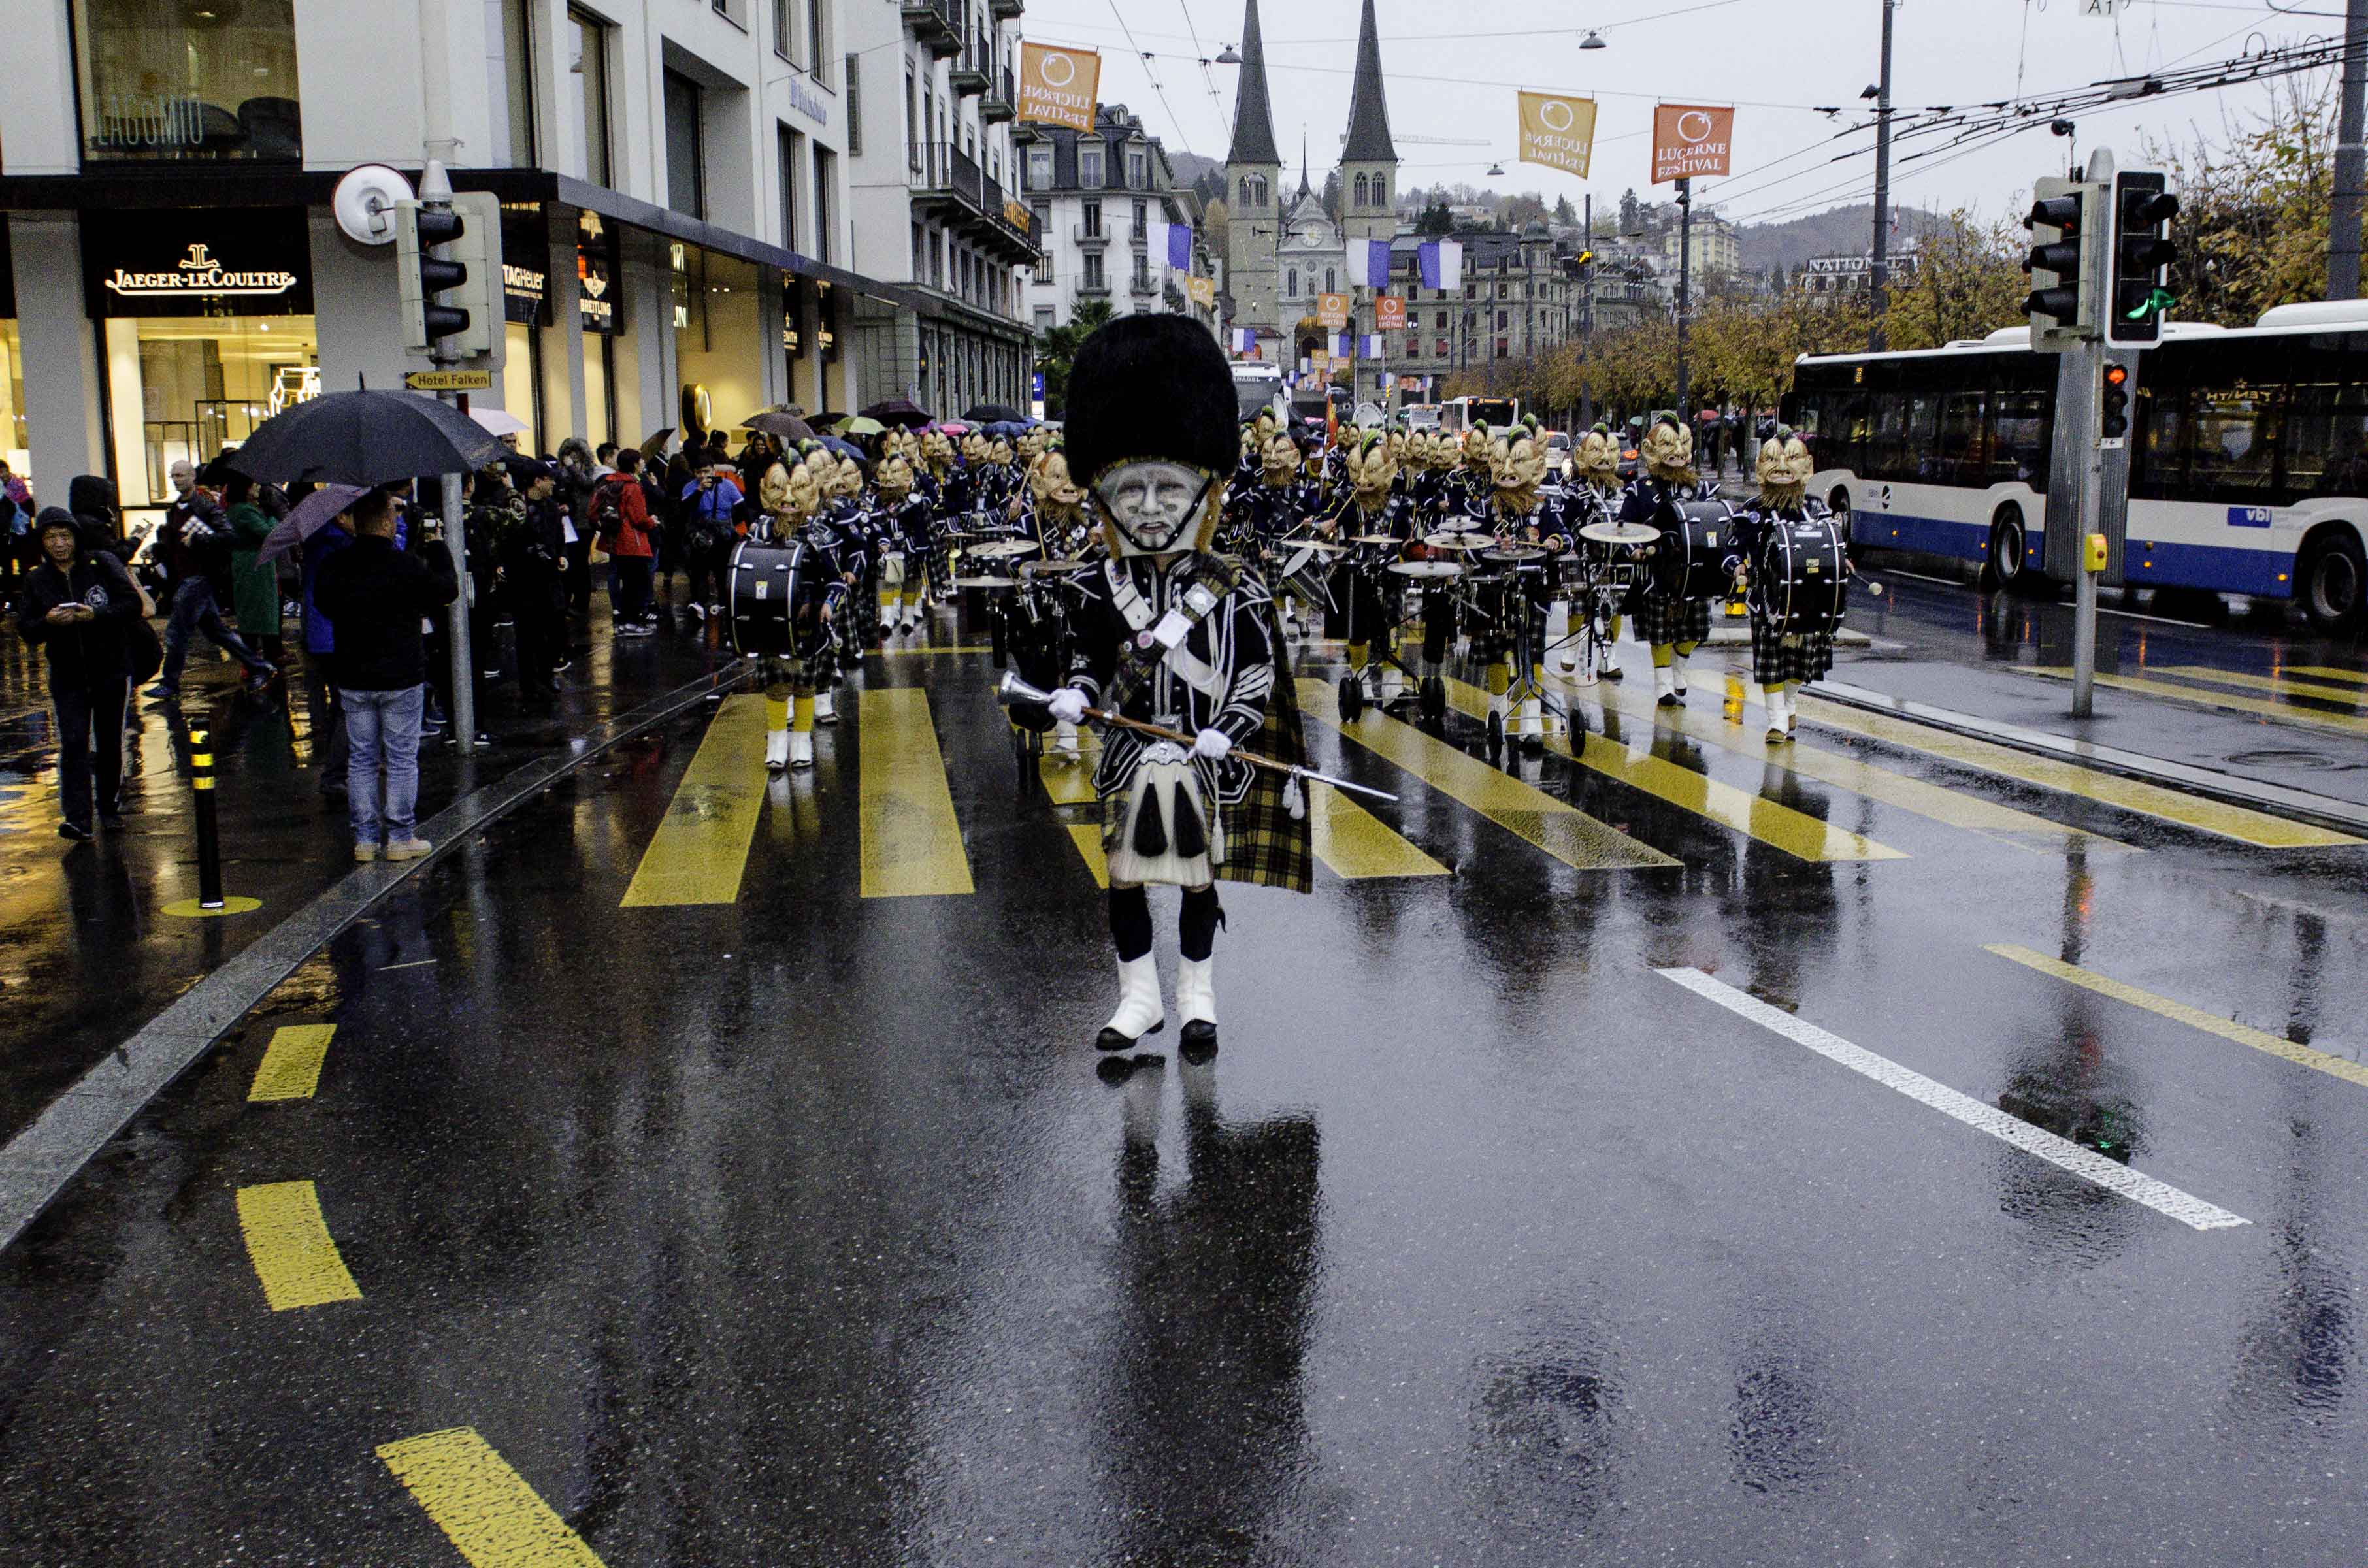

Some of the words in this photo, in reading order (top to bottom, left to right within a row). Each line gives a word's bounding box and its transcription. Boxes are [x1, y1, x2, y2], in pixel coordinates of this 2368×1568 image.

[1658, 142, 1727, 162] LUCERNE
[1657, 157, 1722, 178] FESTIVAL
[418, 375, 448, 385] Hotel
[451, 374, 487, 387] Falken
[2246, 508, 2270, 522] vbl
